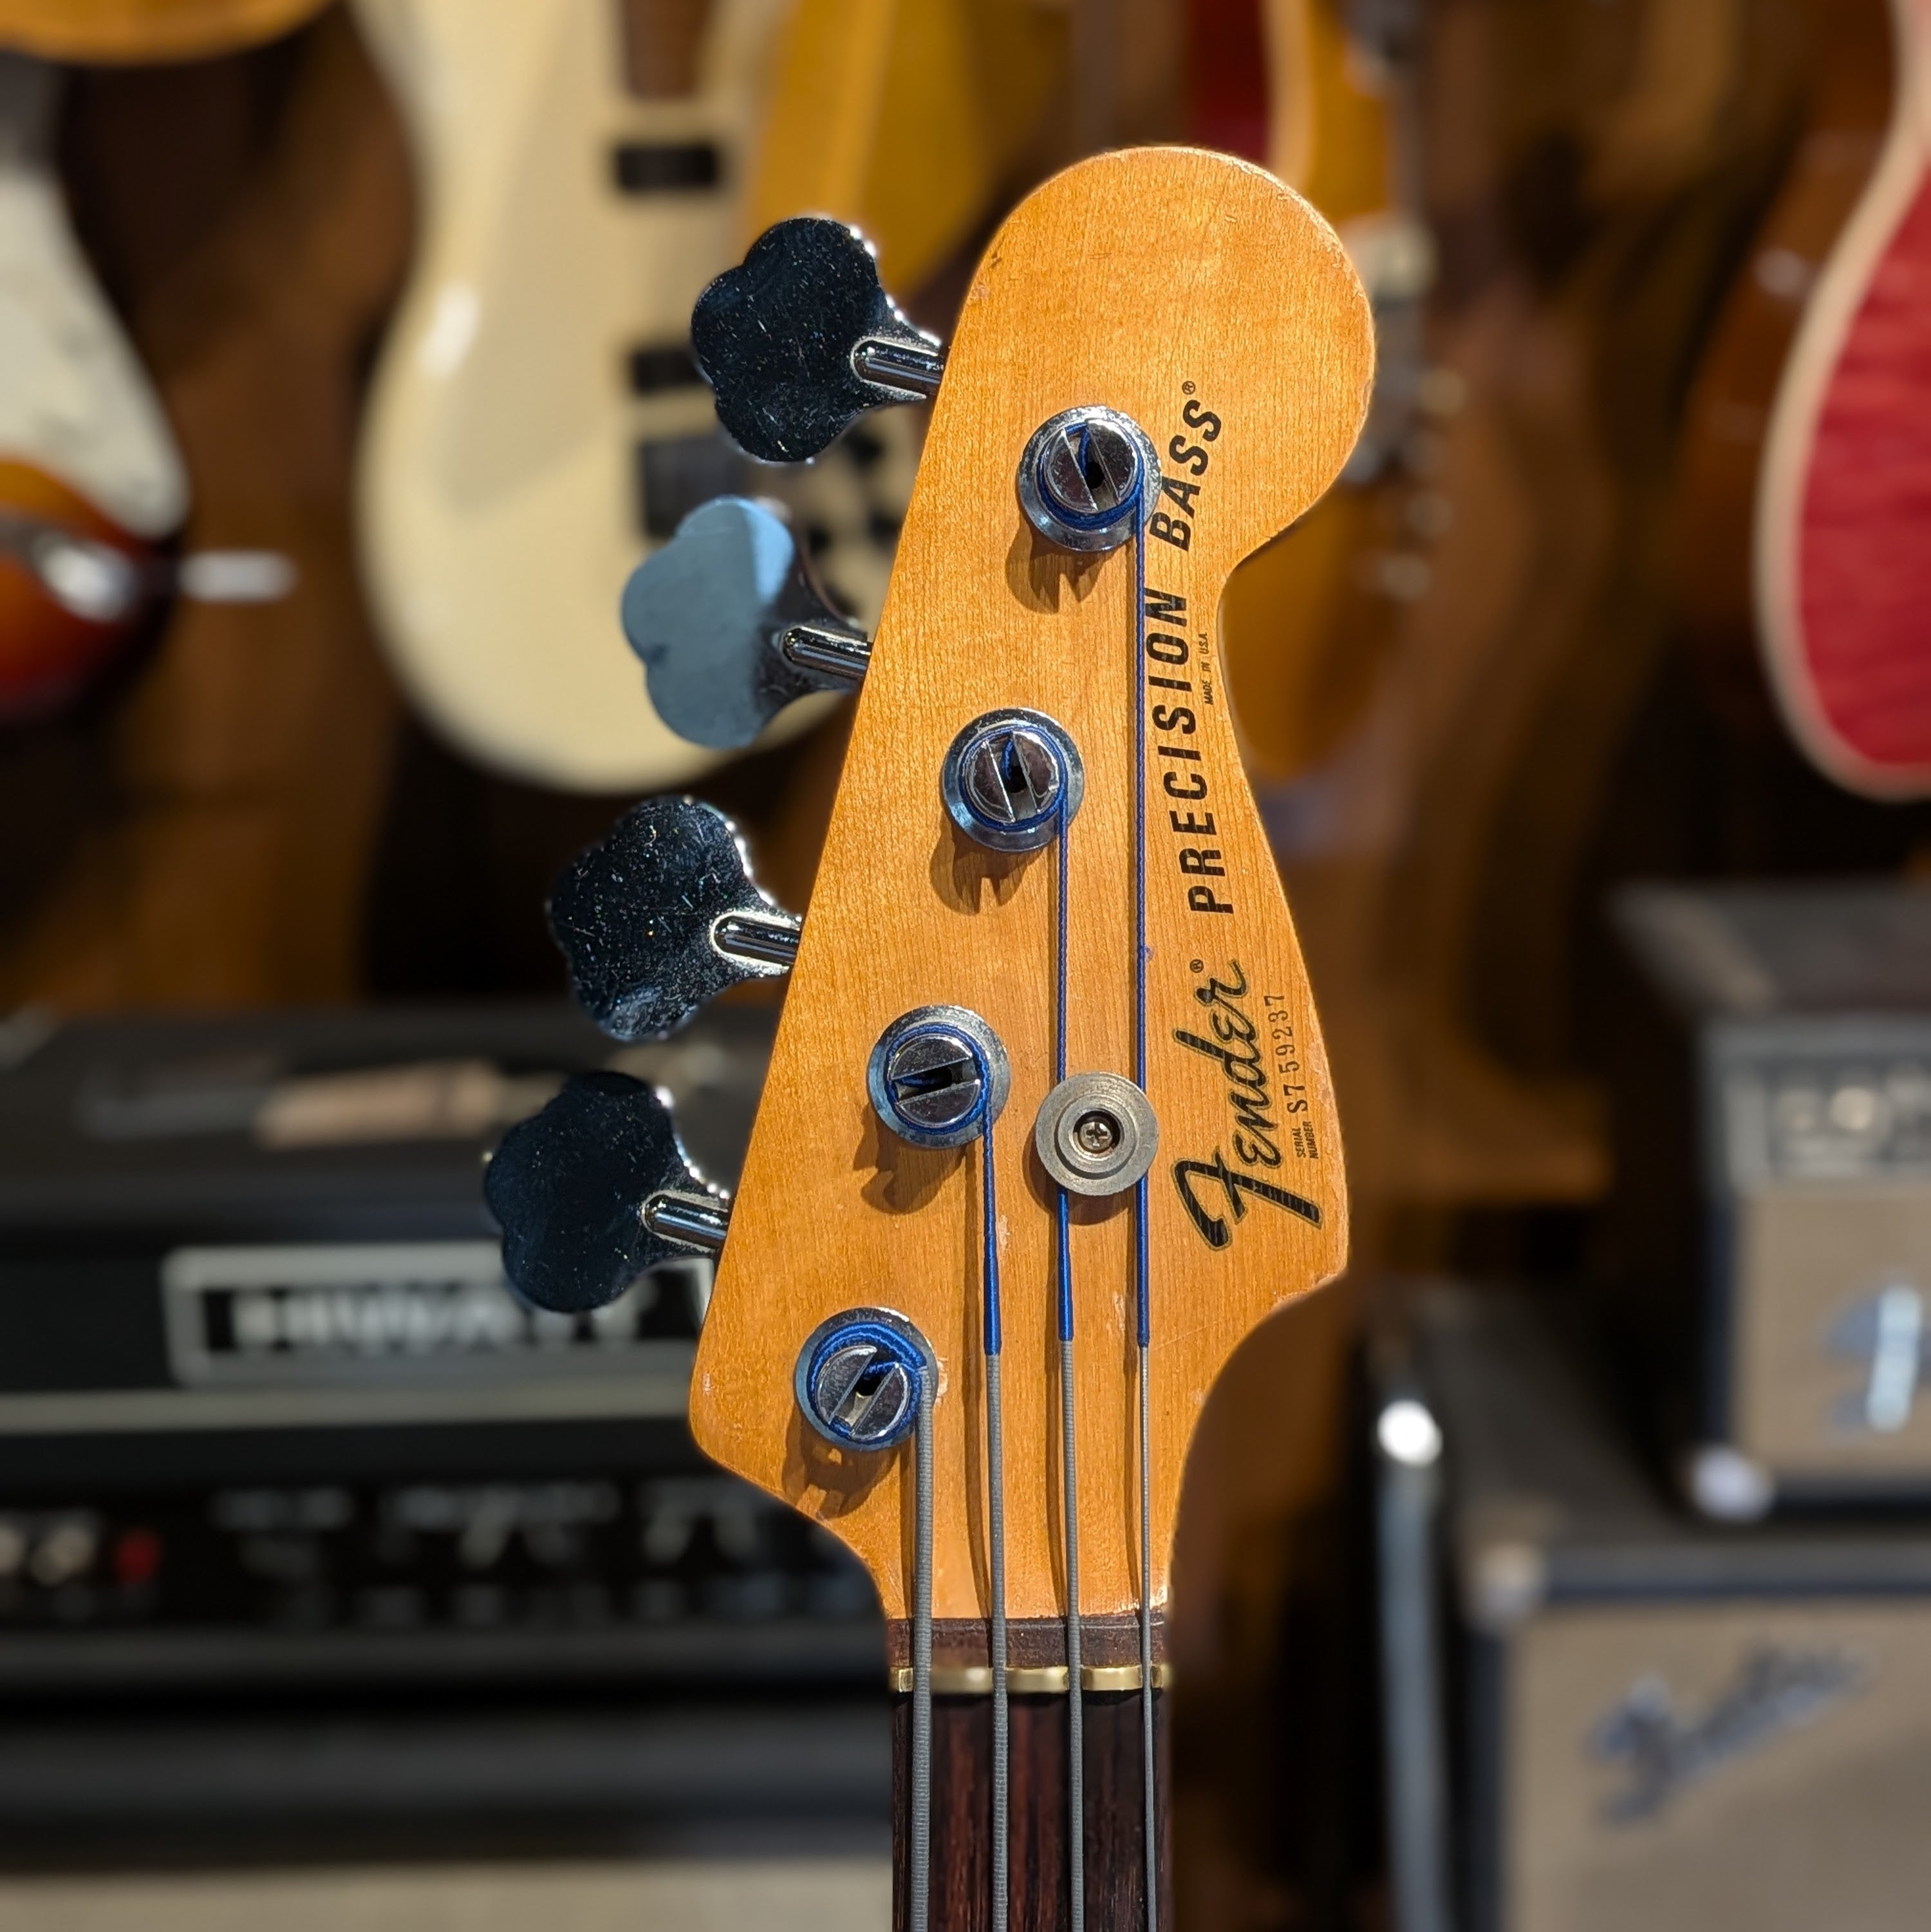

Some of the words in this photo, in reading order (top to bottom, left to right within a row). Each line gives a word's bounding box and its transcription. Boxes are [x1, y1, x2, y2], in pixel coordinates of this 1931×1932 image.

[1201, 661, 1211, 673] IN
[1203, 679, 1214, 705] MADE
[1144, 587, 1234, 914] PRECISION
[1292, 1127, 1307, 1158] SERIAL
[1303, 1121, 1320, 1159] NUMBER
